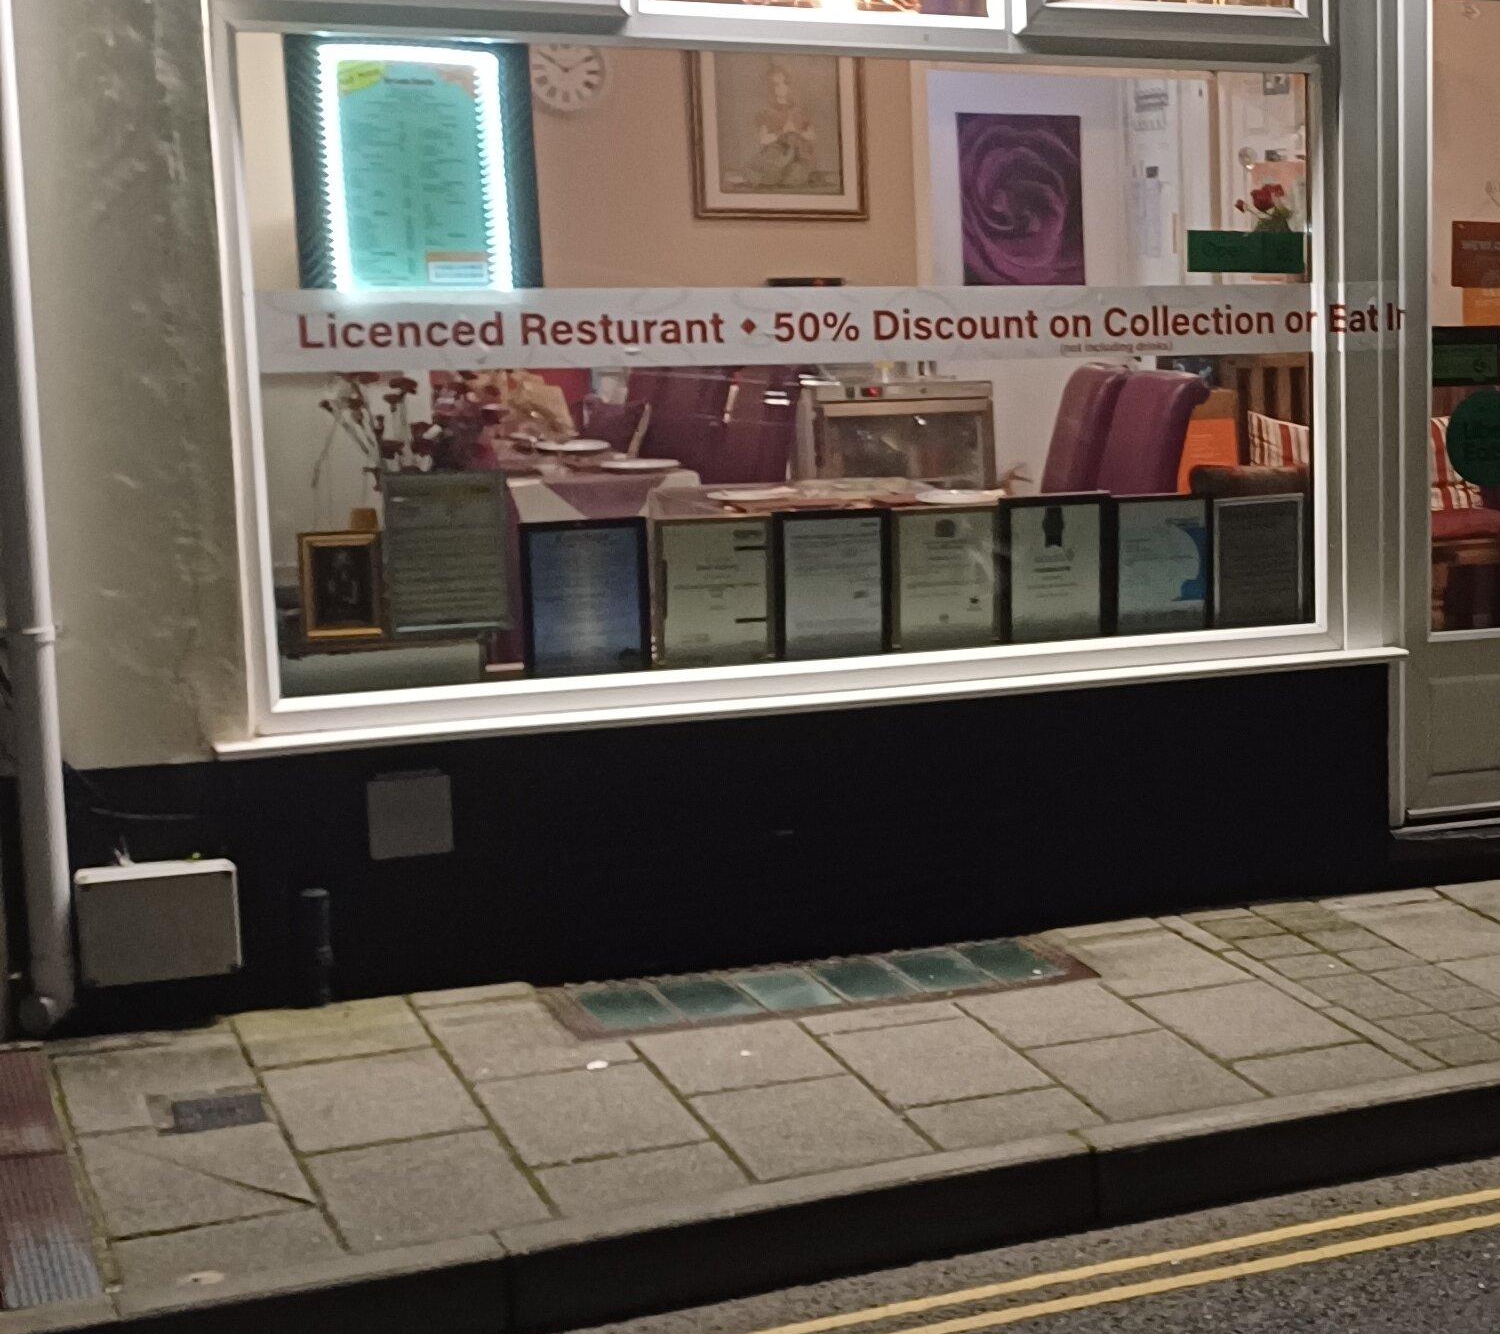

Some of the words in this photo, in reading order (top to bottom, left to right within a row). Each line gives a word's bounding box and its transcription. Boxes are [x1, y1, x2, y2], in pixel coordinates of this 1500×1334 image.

[298, 311, 504, 349] Licenced
[520, 312, 725, 347] Resturant
[773, 310, 860, 344] 50%
[873, 308, 1037, 341] Discount
[1049, 313, 1092, 338] on
[1104, 304, 1279, 337] Collection
[1285, 310, 1318, 333] or
[1329, 304, 1378, 333] Eat
